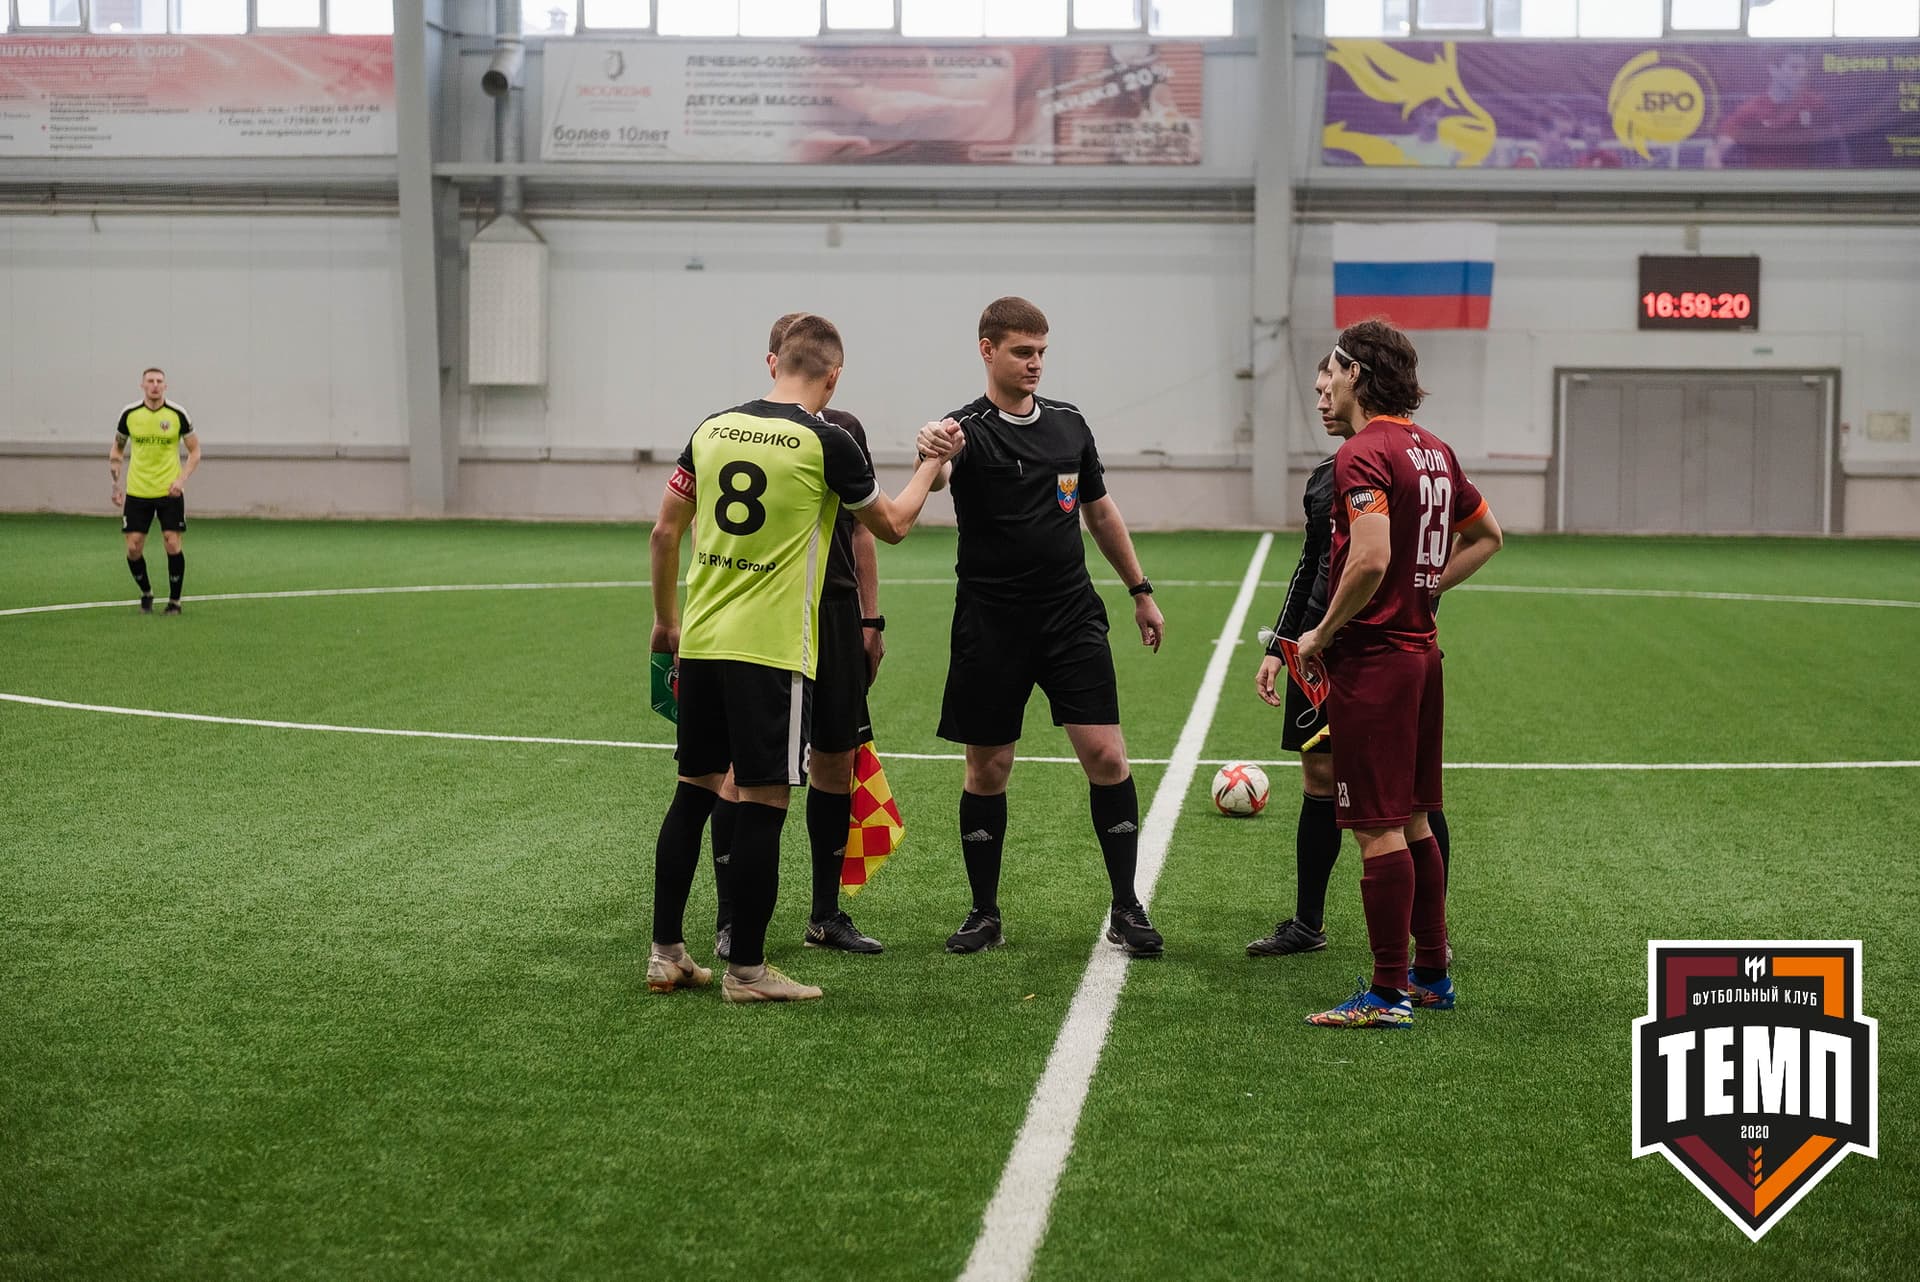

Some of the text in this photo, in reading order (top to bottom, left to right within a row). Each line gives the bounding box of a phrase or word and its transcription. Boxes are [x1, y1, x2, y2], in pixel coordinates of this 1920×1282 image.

[0, 44, 82, 58] ШТАТНЫЙ
[686, 92, 760, 107] ДЕТСКИЙ
[553, 124, 611, 142] более
[1643, 292, 1751, 319] 16:59:20
[714, 460, 768, 536] 8
[1416, 474, 1451, 567] 23
[709, 554, 732, 568] RVM
[1337, 781, 1350, 808] 23
